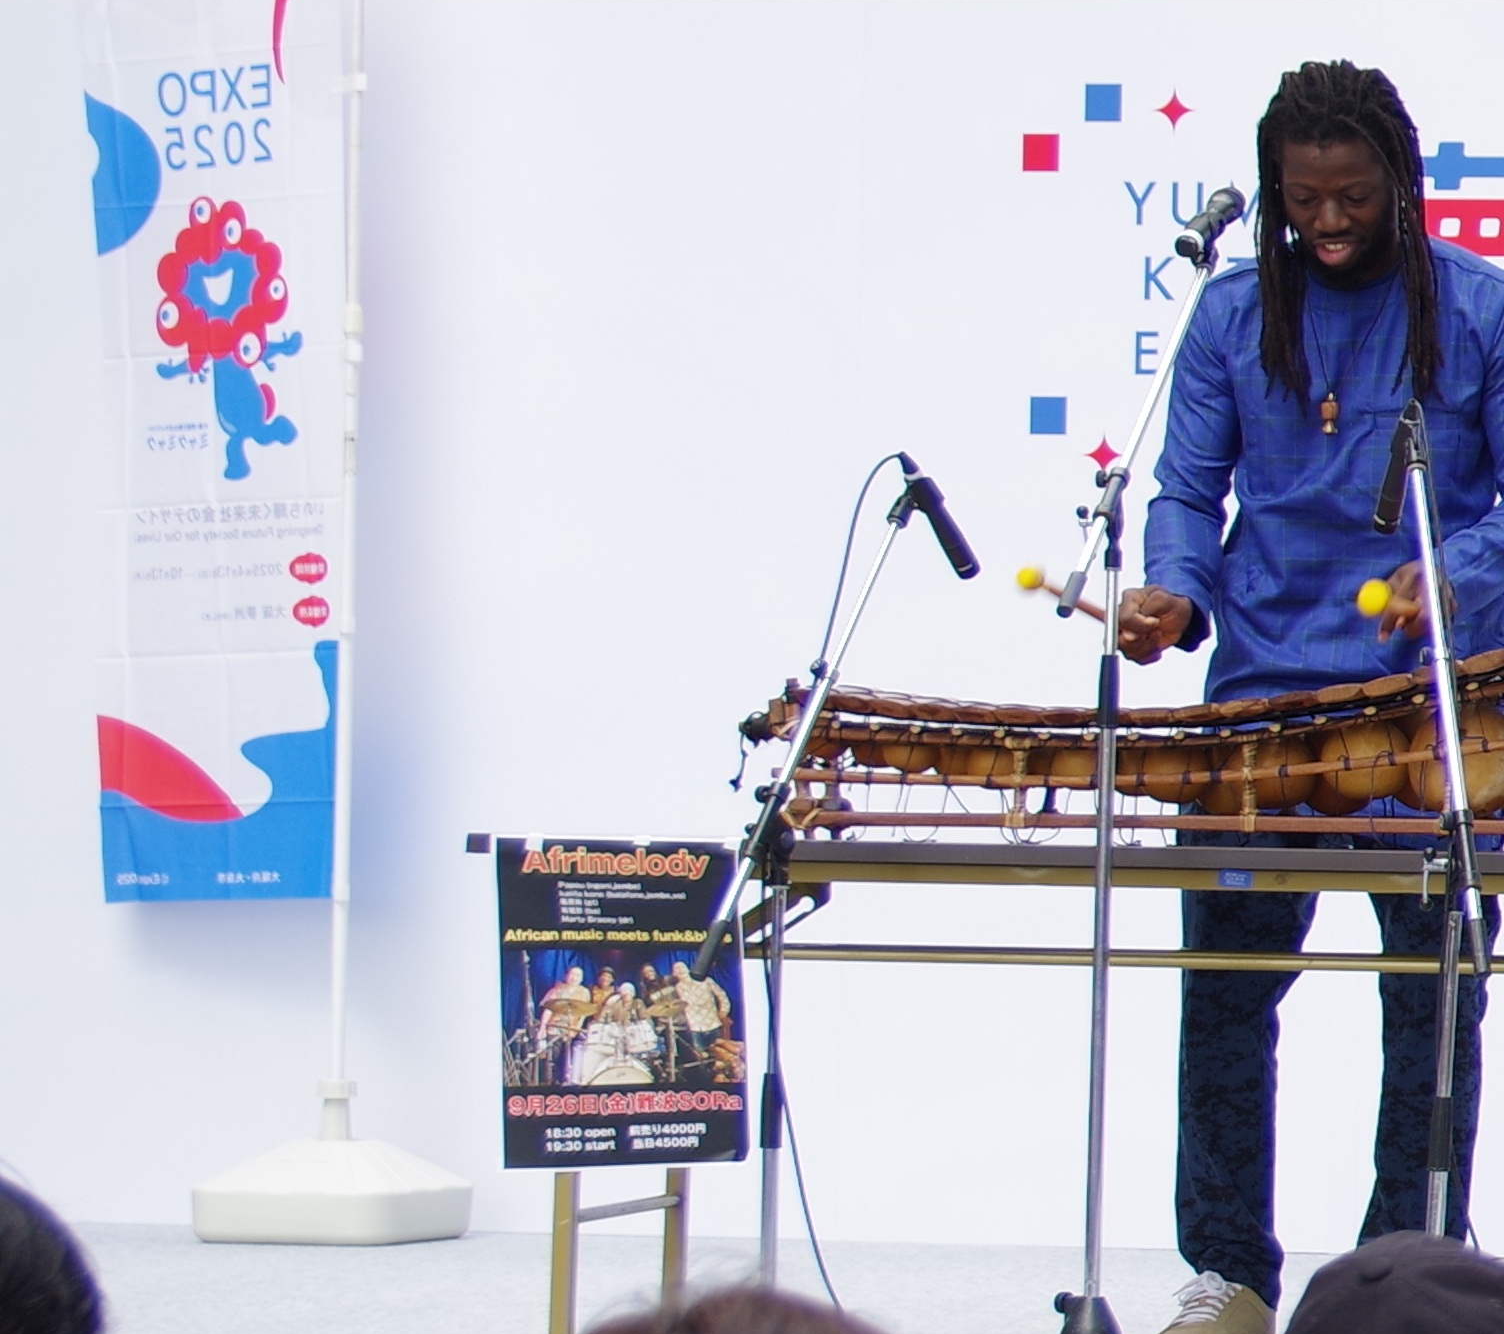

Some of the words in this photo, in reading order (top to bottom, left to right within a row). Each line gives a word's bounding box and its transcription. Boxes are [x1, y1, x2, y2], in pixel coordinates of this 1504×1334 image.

[521, 846, 709, 880] Afrimelody
[505, 928, 560, 943] African
[562, 928, 604, 942] music
[607, 929, 650, 943] meets
[545, 1127, 582, 1139] 18:30
[584, 1127, 617, 1140] open
[545, 1140, 582, 1152] 19:30
[584, 1139, 617, 1152] start
